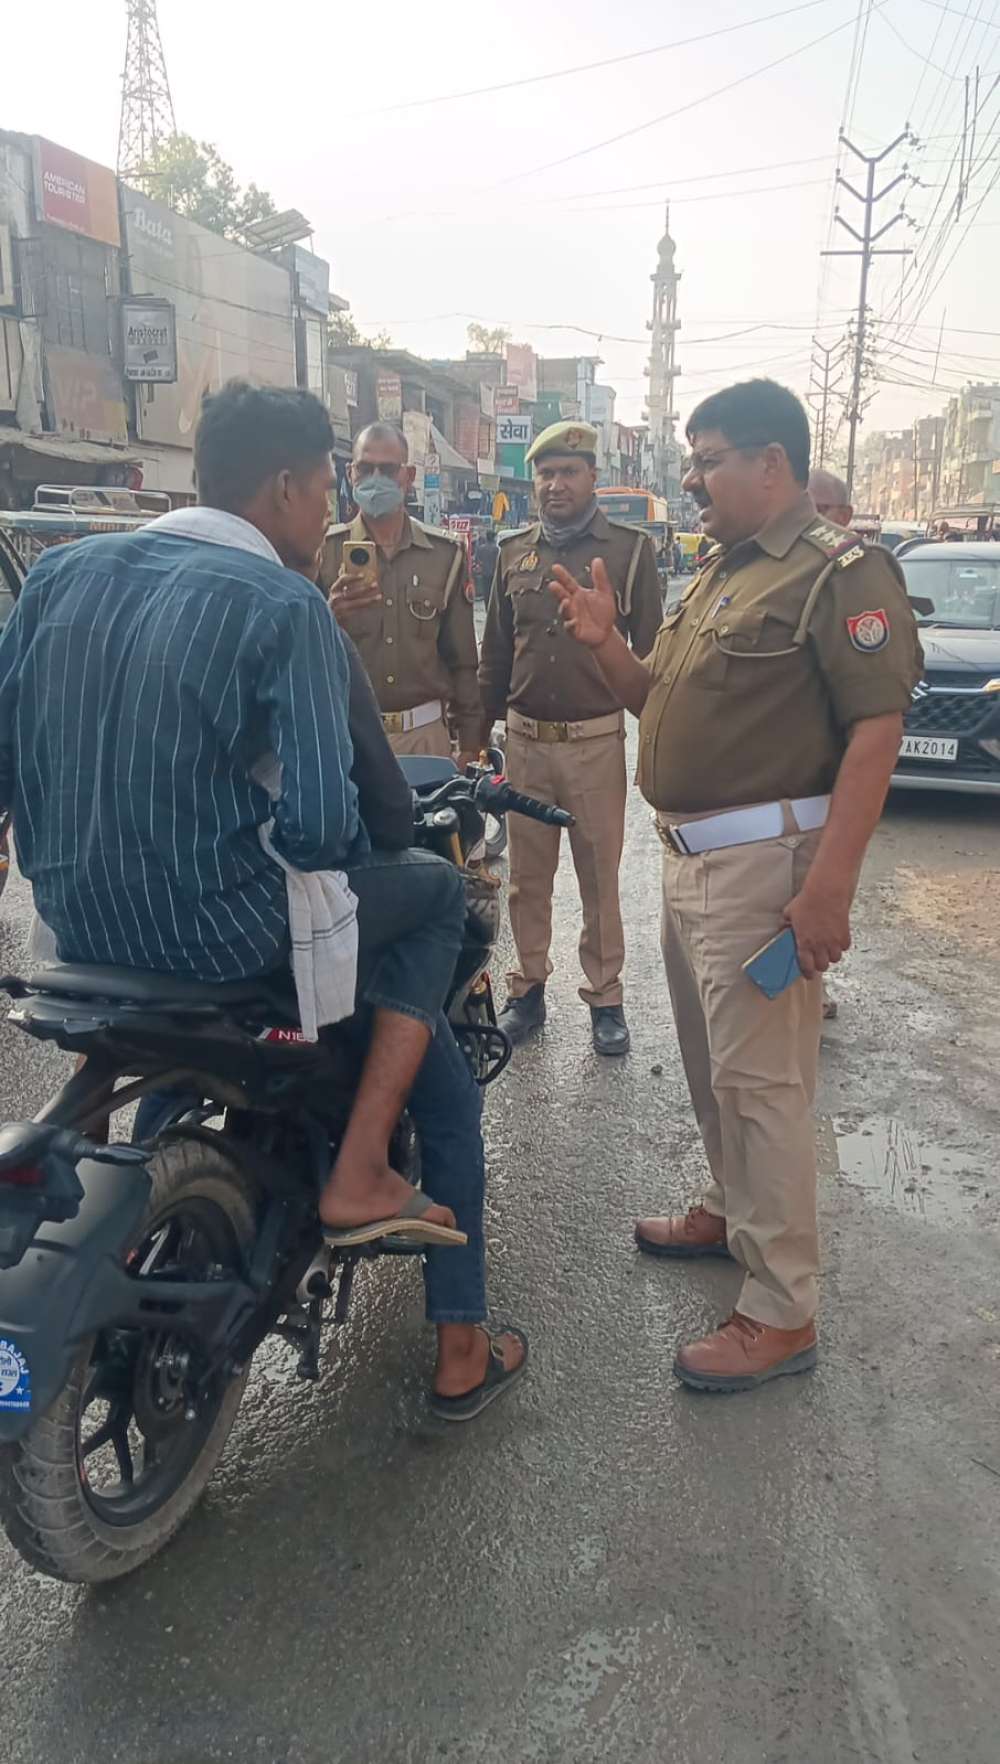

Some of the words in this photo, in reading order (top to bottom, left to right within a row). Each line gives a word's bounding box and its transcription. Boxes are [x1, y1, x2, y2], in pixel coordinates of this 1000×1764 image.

[43, 171, 86, 197] AMERICAN
[133, 207, 172, 245] Bata
[128, 325, 168, 337] Aristocrat
[500, 418, 529, 440] सेवा
[0, 1339, 30, 1374] BAJAJ
